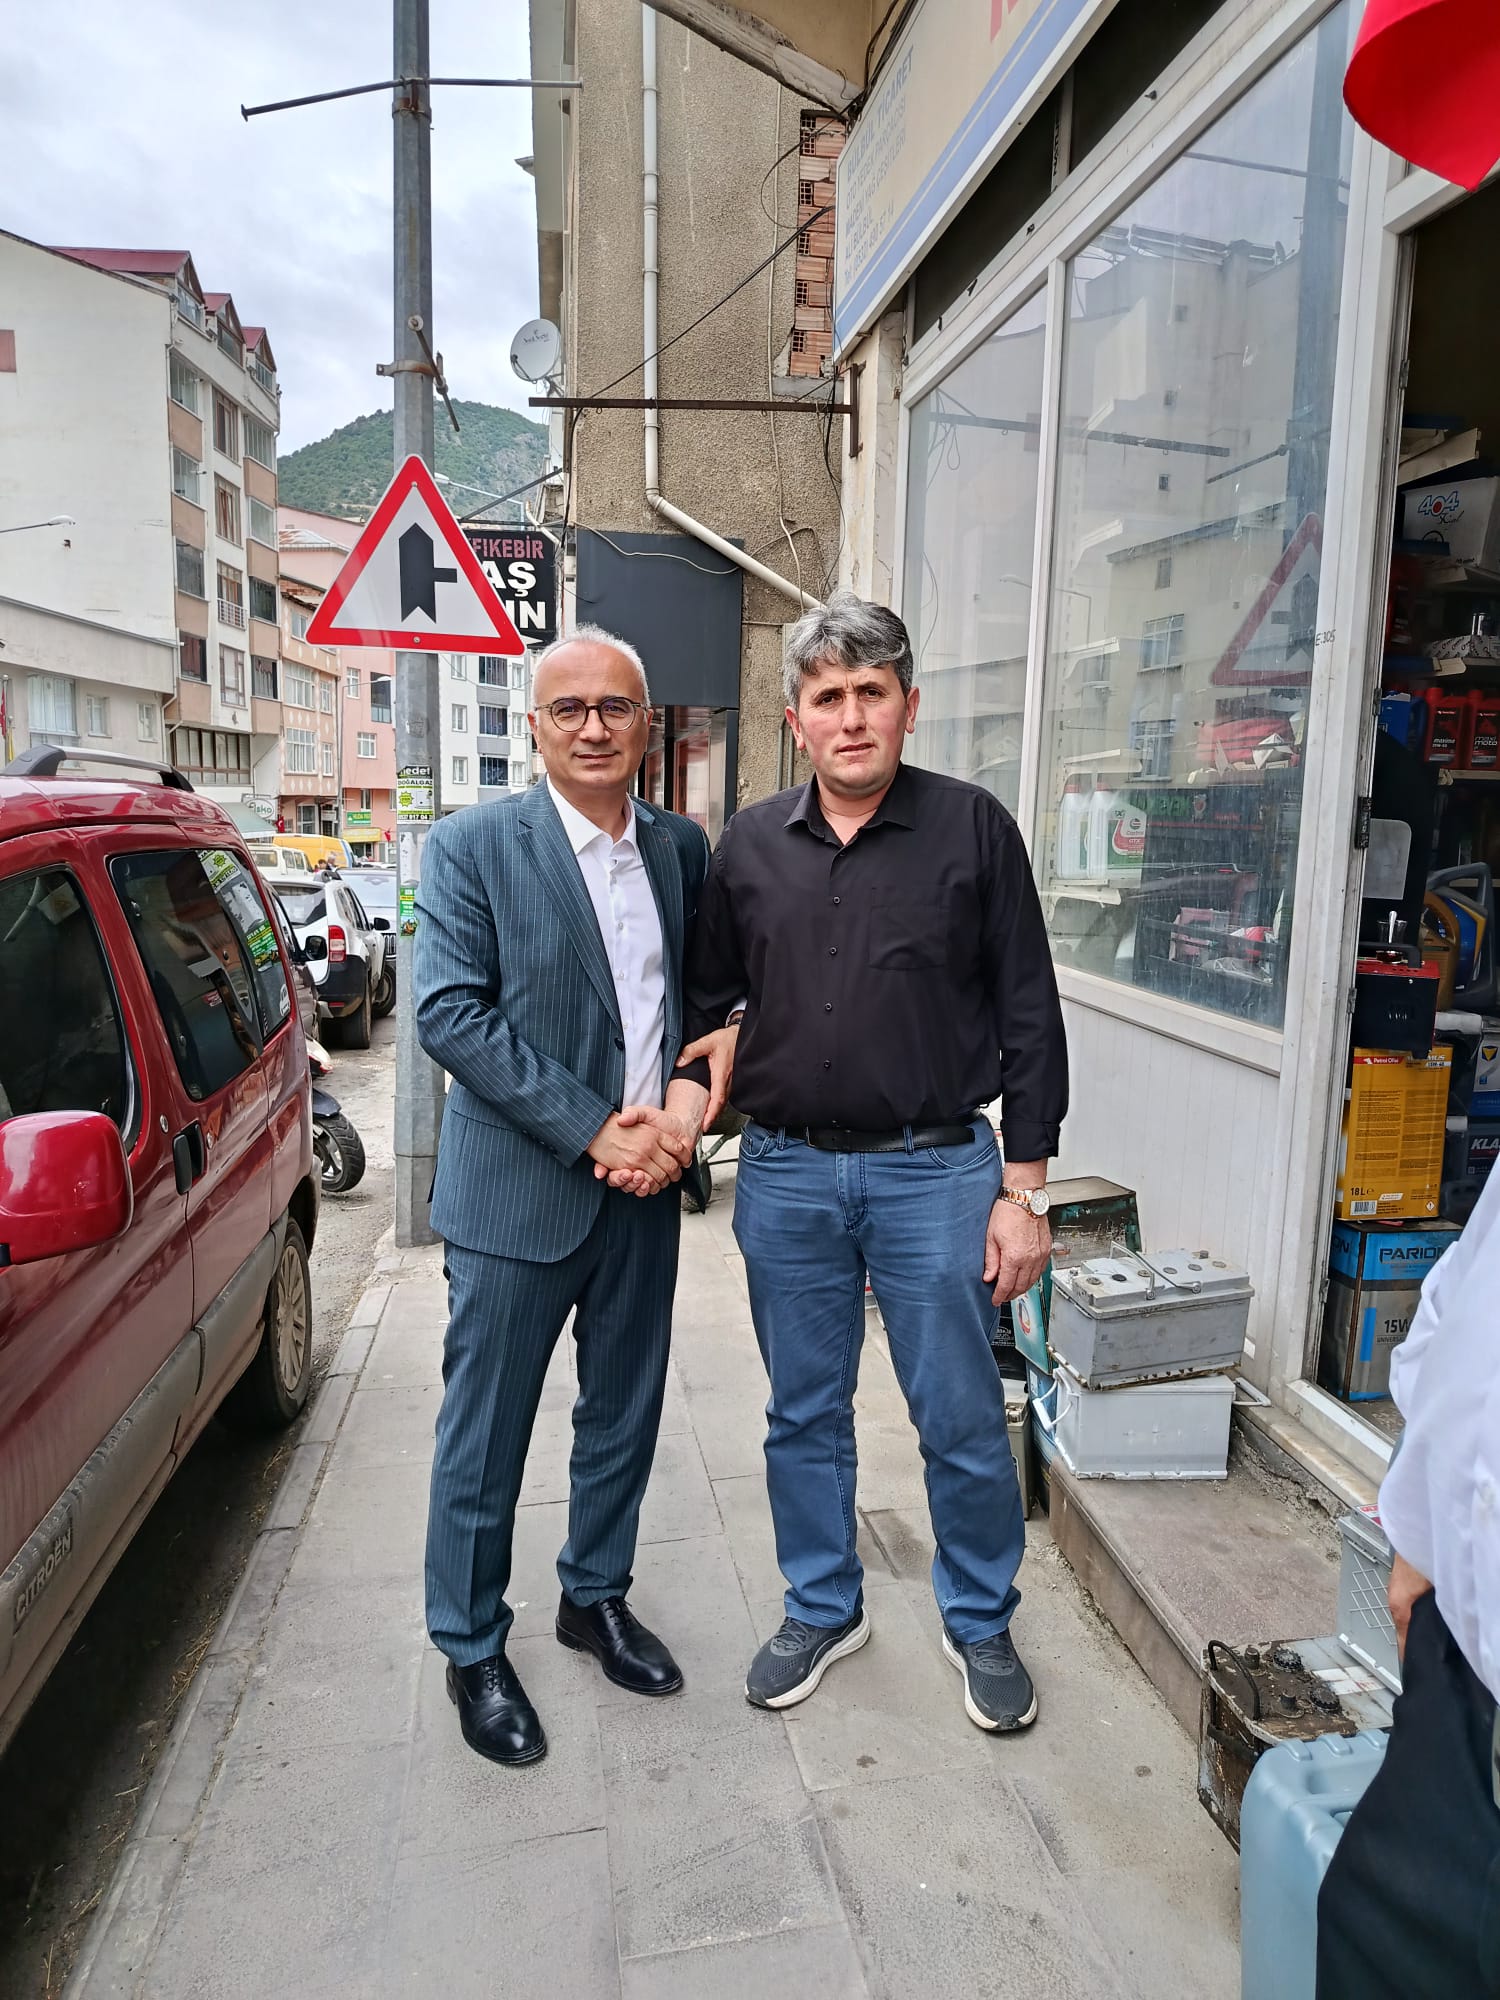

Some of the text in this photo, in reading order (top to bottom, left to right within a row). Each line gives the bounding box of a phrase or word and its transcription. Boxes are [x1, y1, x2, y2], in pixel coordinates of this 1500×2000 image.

[1418, 490, 1460, 517] 404
[468, 535, 544, 559] FIKEBİR
[1470, 1138, 1500, 1150] KLA
[15, 1526, 72, 1623] CITROËN
